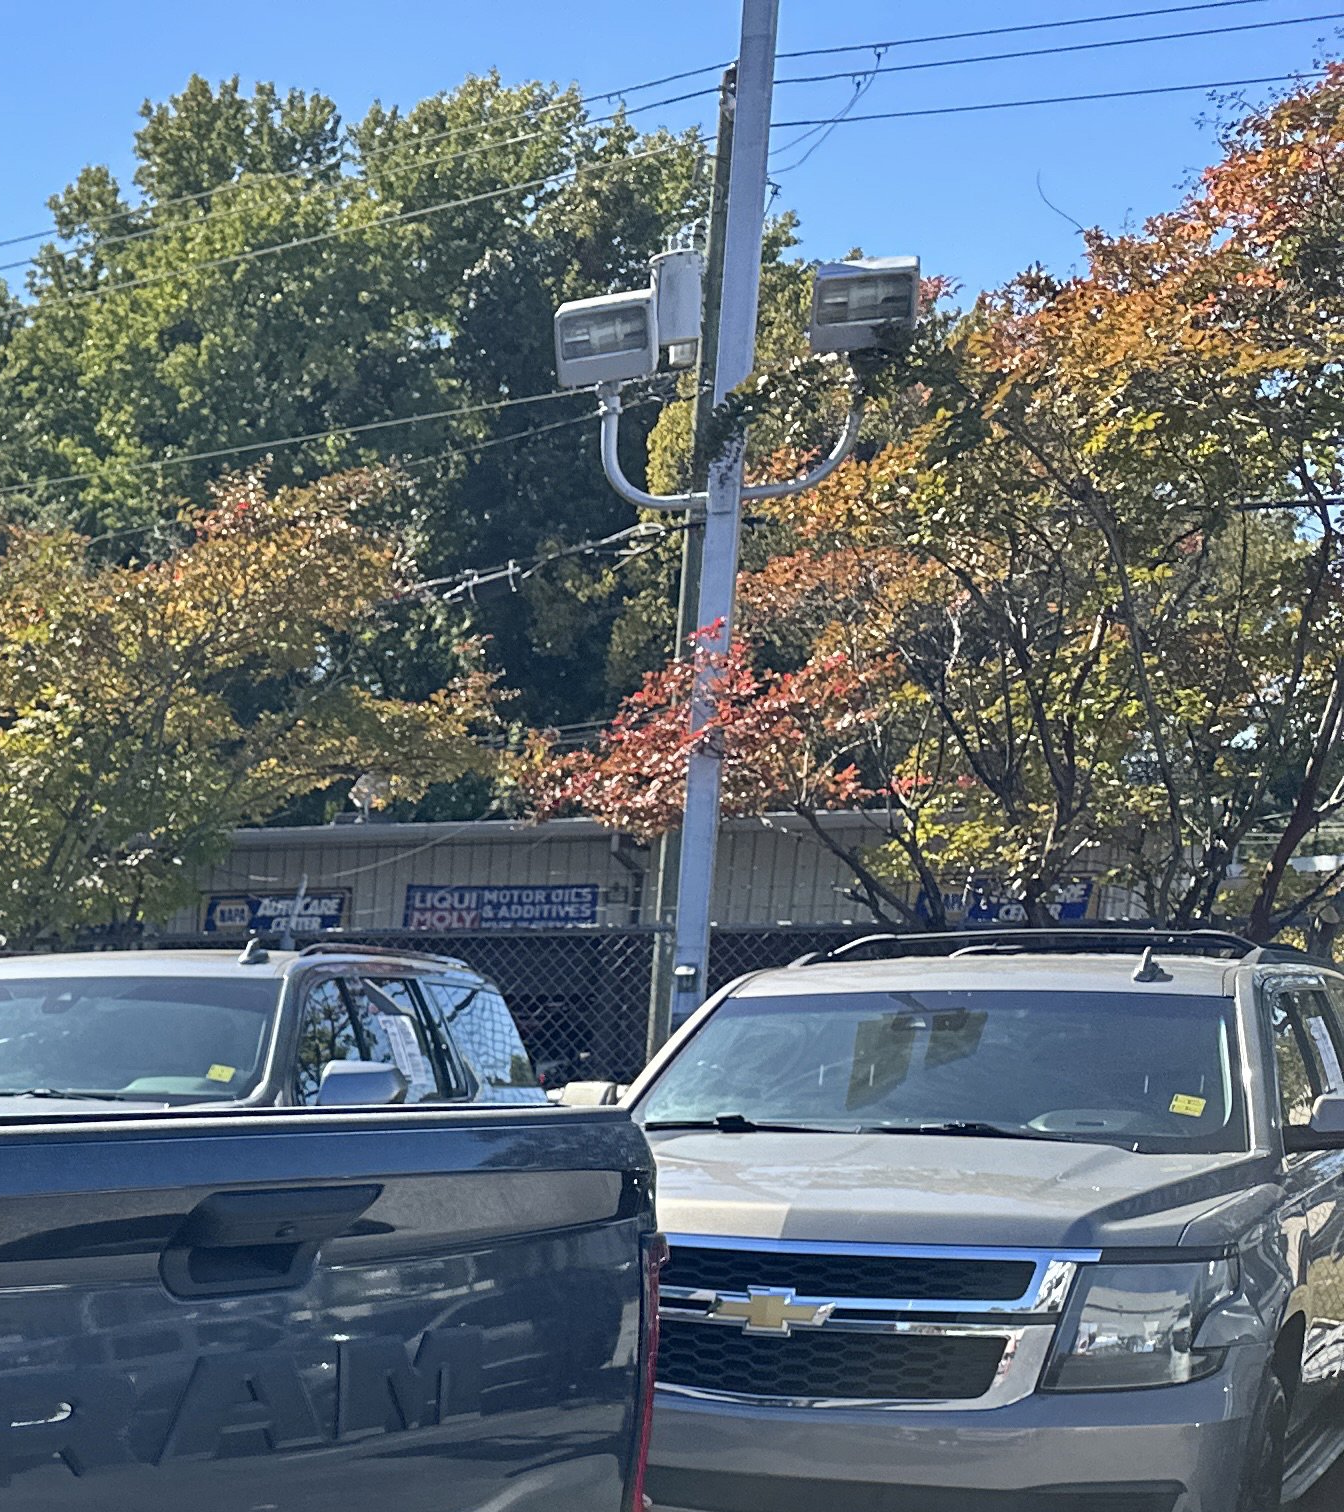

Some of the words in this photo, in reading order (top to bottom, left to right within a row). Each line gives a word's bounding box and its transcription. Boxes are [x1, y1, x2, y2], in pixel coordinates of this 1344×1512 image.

[414, 891, 477, 909] LIQUI
[483, 889, 545, 903] MOTOR
[552, 888, 593, 902] OILS
[482, 904, 493, 918] &
[497, 904, 592, 918] ADDITIVES
[411, 910, 476, 929] MOLY
